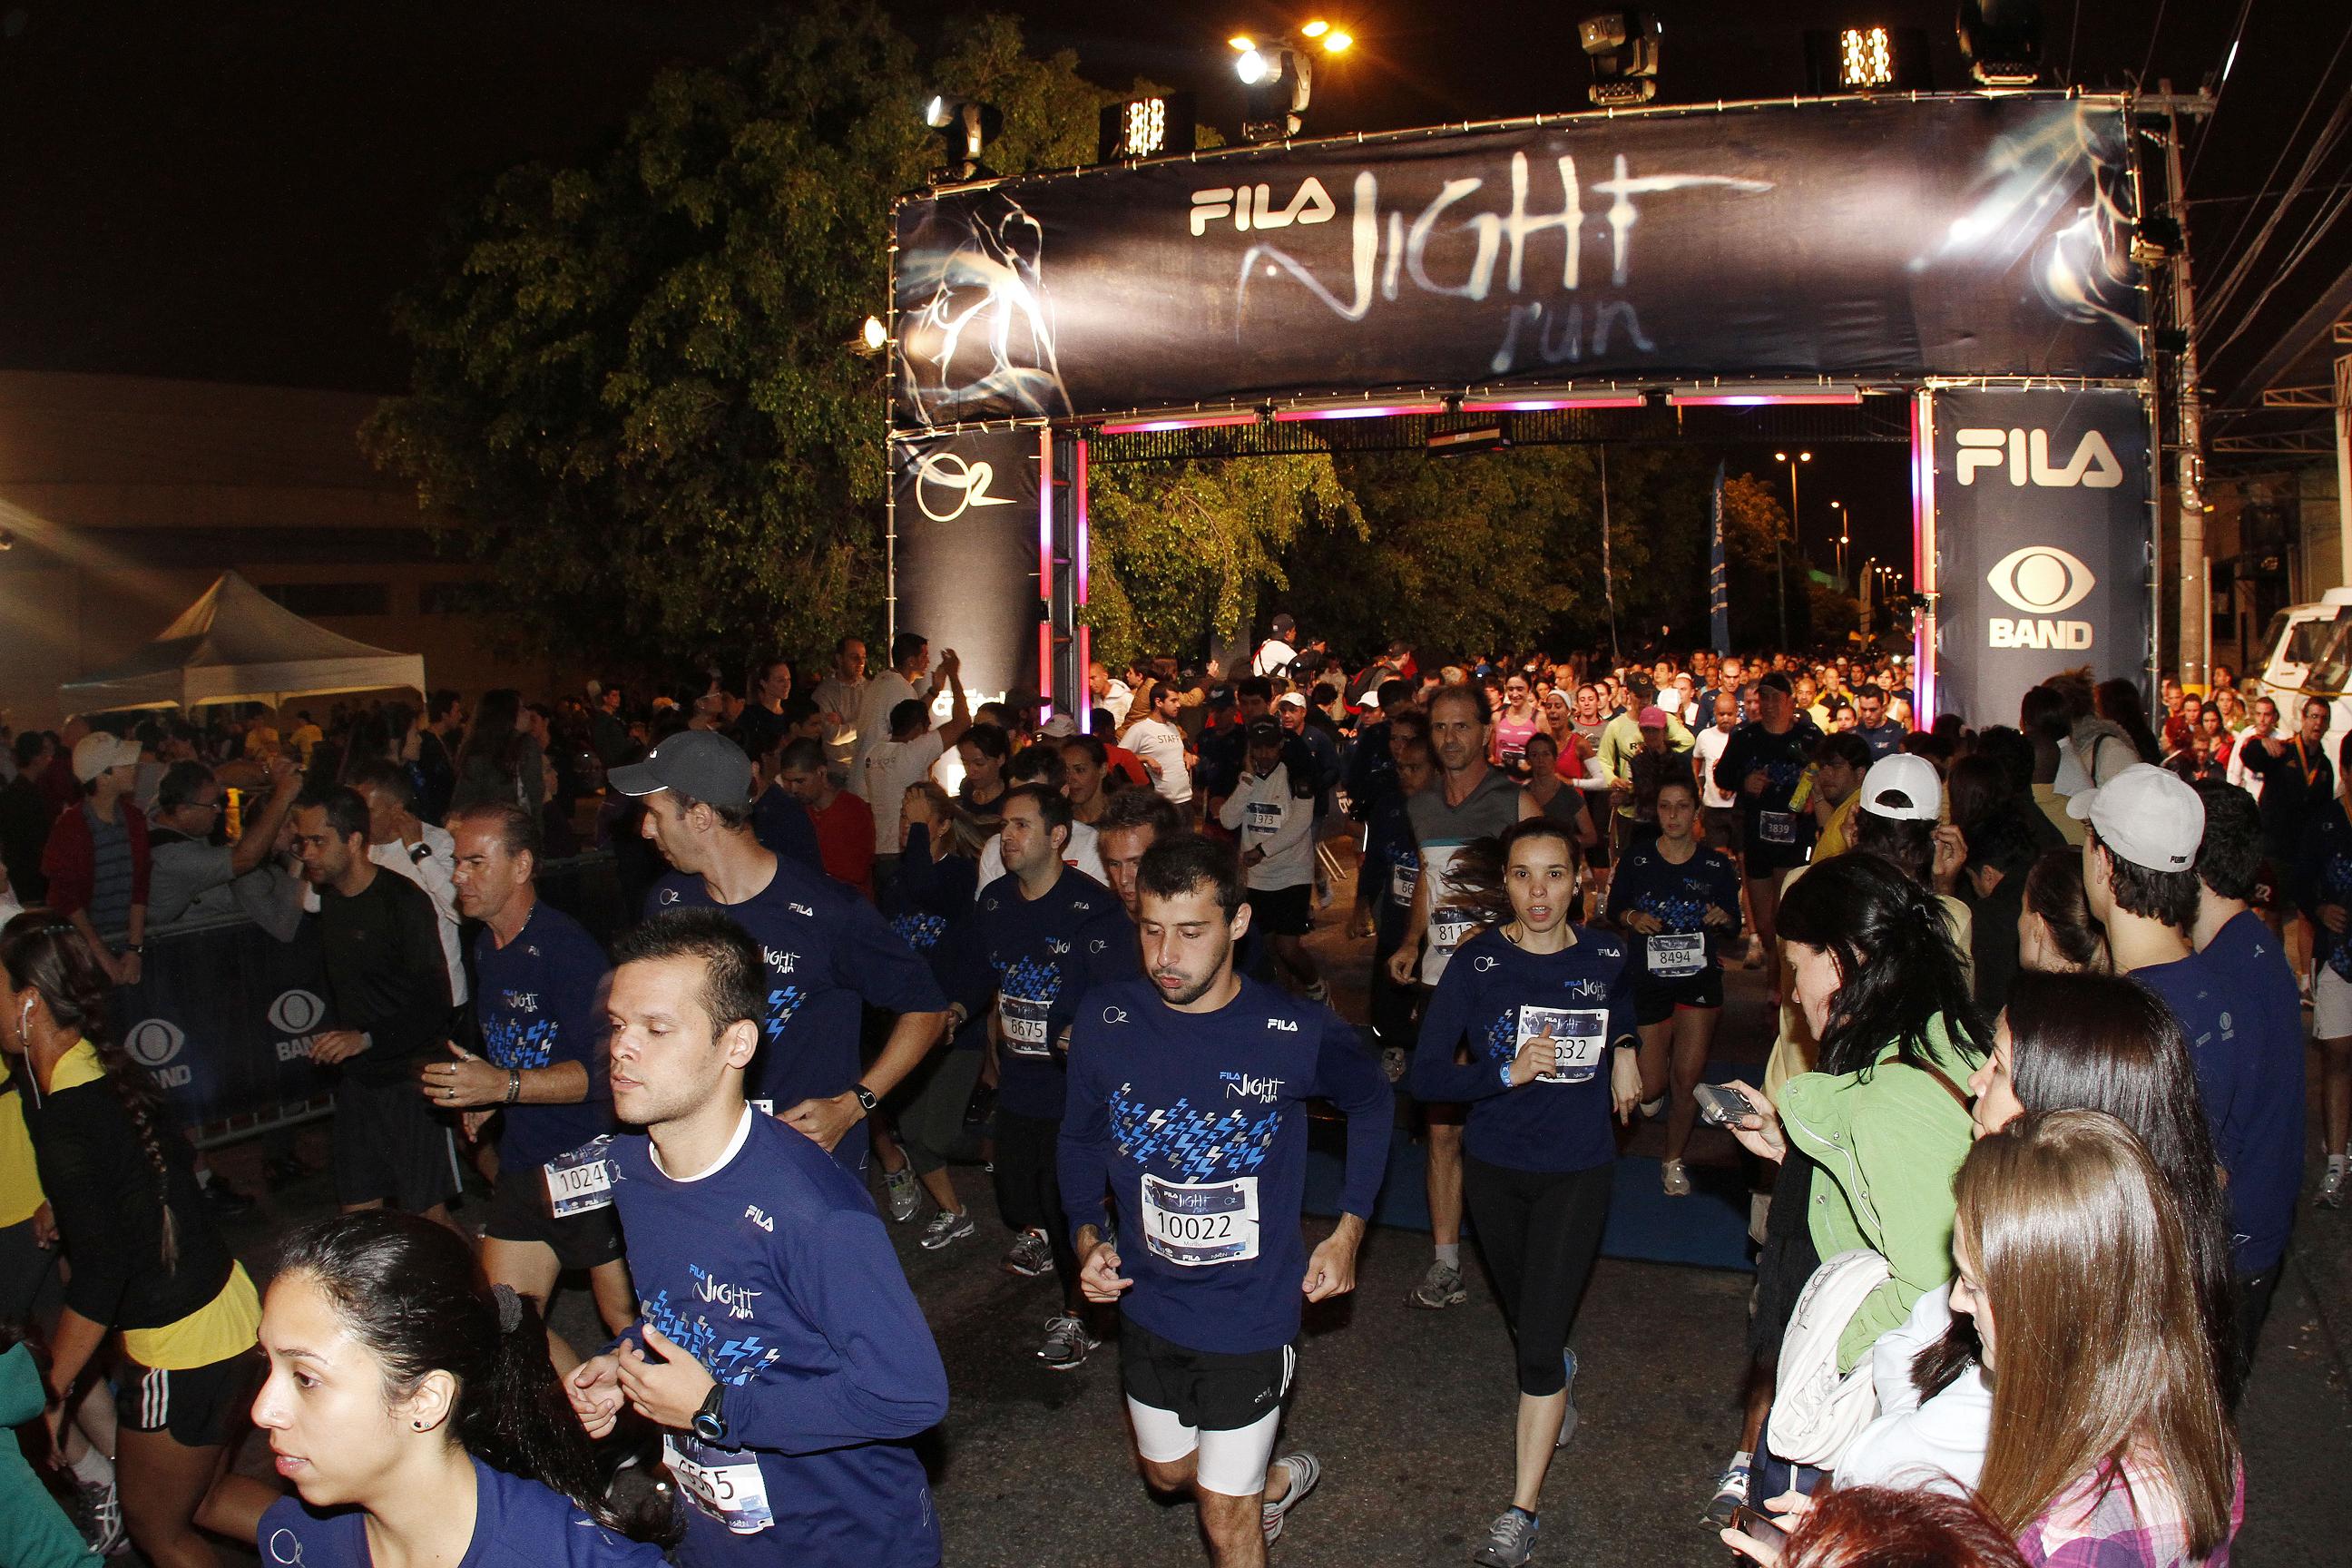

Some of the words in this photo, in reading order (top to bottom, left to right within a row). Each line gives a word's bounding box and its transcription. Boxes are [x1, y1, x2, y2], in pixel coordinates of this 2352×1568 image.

[1191, 177, 1336, 238] FILA
[1237, 152, 1775, 344] NIGHT
[1491, 300, 1657, 374] run
[1956, 428, 2123, 487] FILA
[1989, 618, 2093, 651] BAND
[789, 903, 813, 916] FILA
[1073, 901, 1089, 909] FILA
[1597, 948, 1621, 957] FILA
[1660, 951, 1690, 964] 8494
[777, 965, 794, 974] run
[1011, 1019, 1043, 1037] 6675
[1268, 1019, 1298, 1032] FILA
[276, 1033, 322, 1062] BAN
[1220, 1072, 1240, 1081] FILA
[1227, 1073, 1285, 1098] NIGHT
[1259, 1093, 1277, 1103] run
[1163, 1191, 1179, 1199] FILA
[744, 1204, 774, 1232] FILA
[1158, 1211, 1231, 1240] 10022
[690, 1263, 705, 1280] FILA
[692, 1274, 762, 1309] NIGHT
[729, 1305, 754, 1319] run
